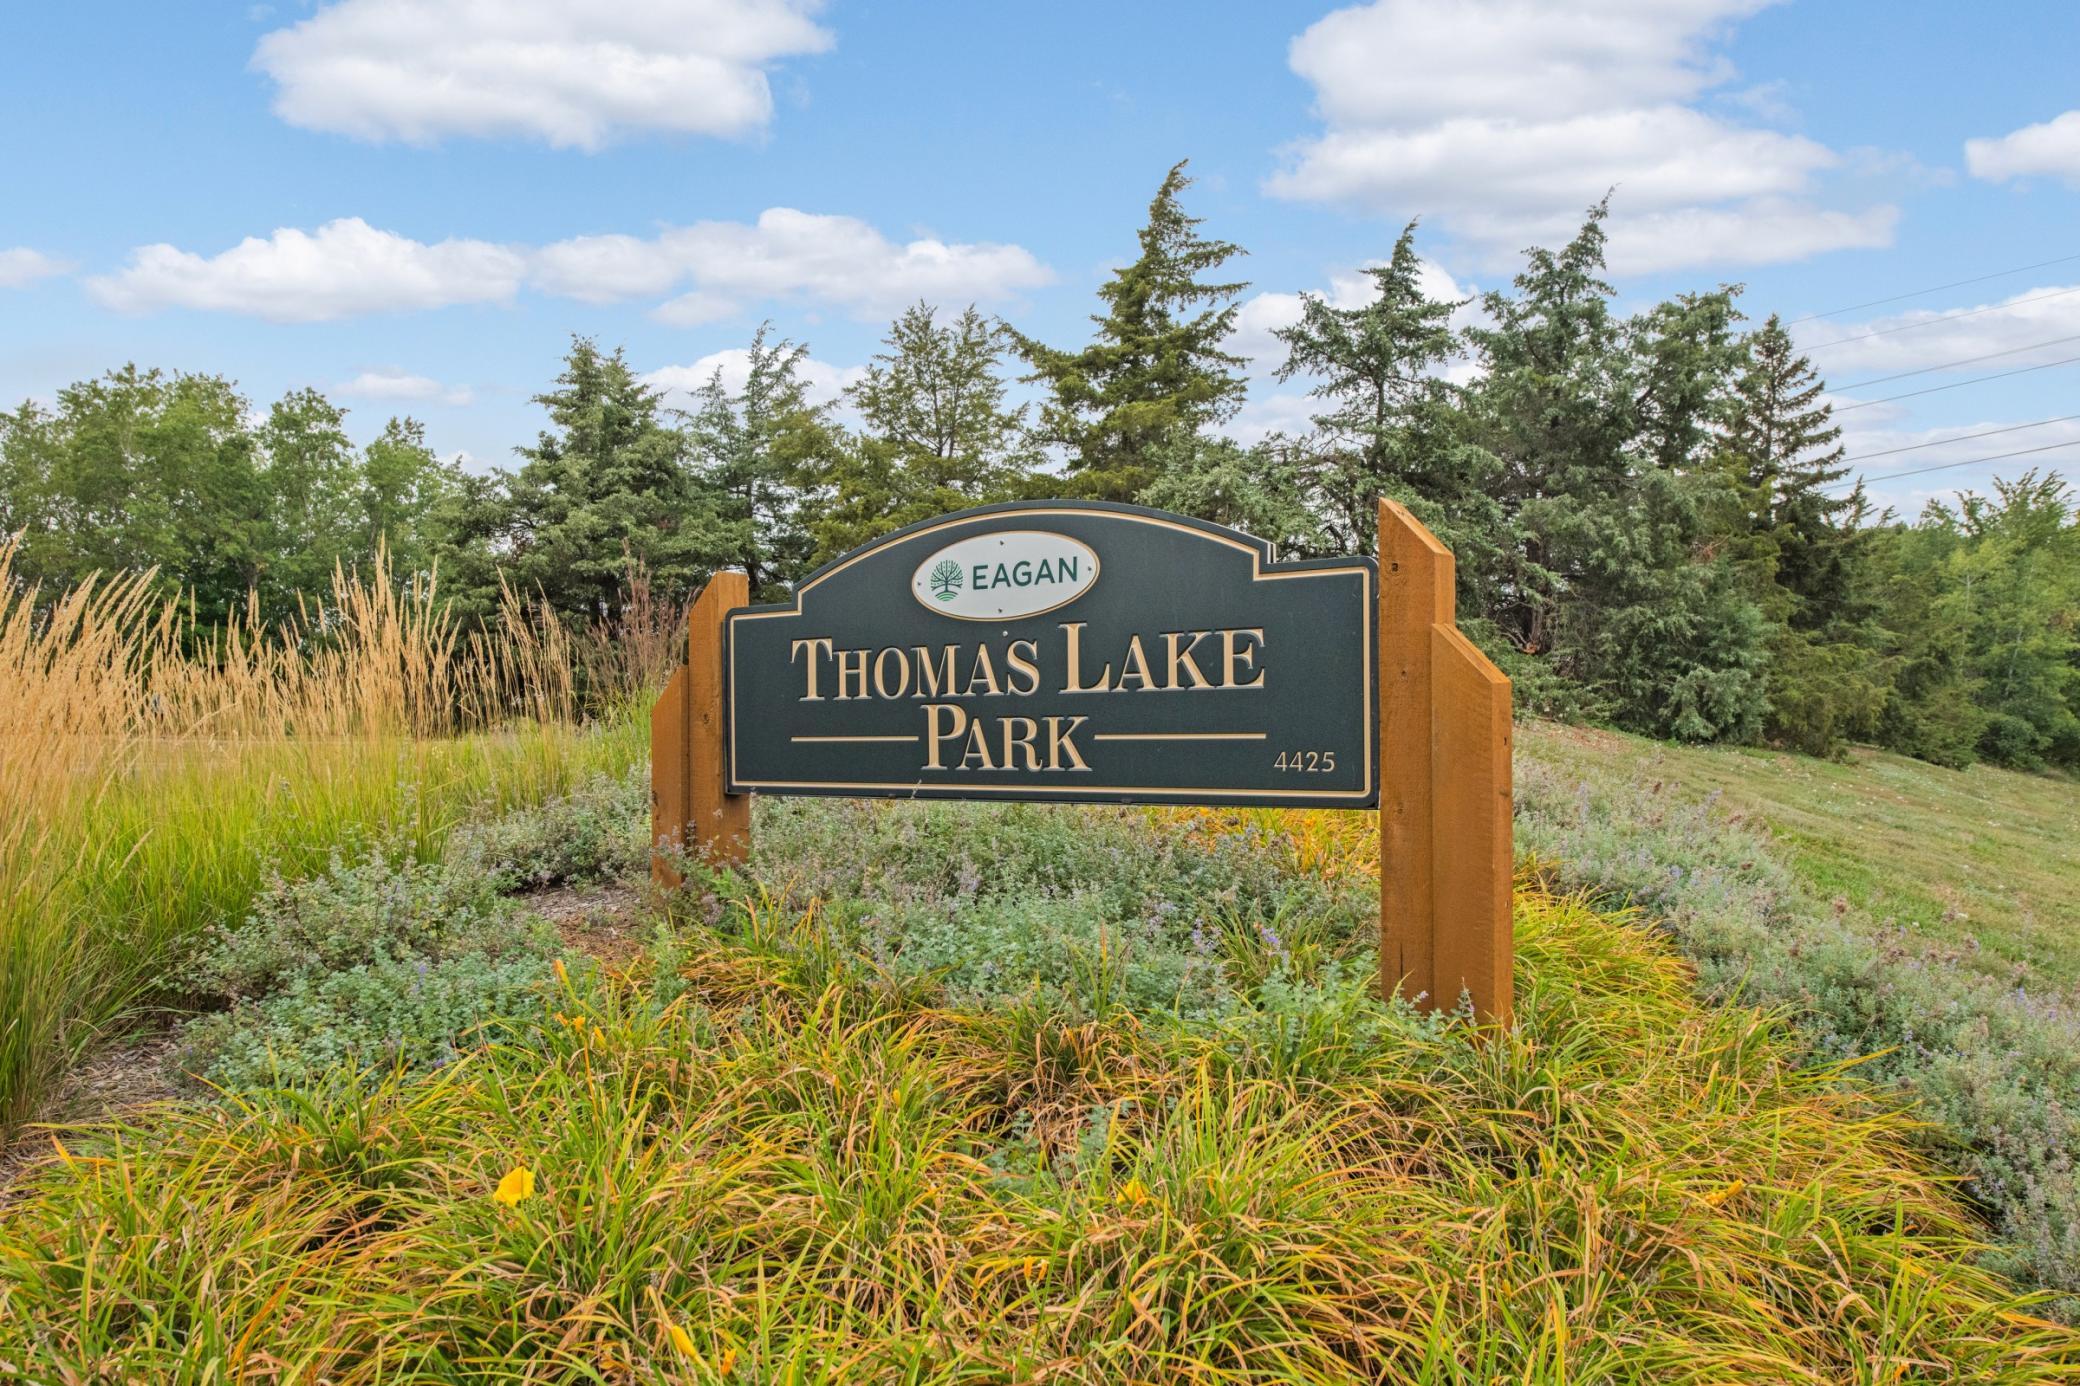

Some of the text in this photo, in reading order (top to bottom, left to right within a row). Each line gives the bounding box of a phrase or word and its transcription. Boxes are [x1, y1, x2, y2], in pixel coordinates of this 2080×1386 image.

[972, 555, 1079, 591] EAGAN
[790, 622, 1266, 701] THOMAS LAKE
[920, 703, 1093, 773] PARK
[1273, 751, 1336, 773] 4425
